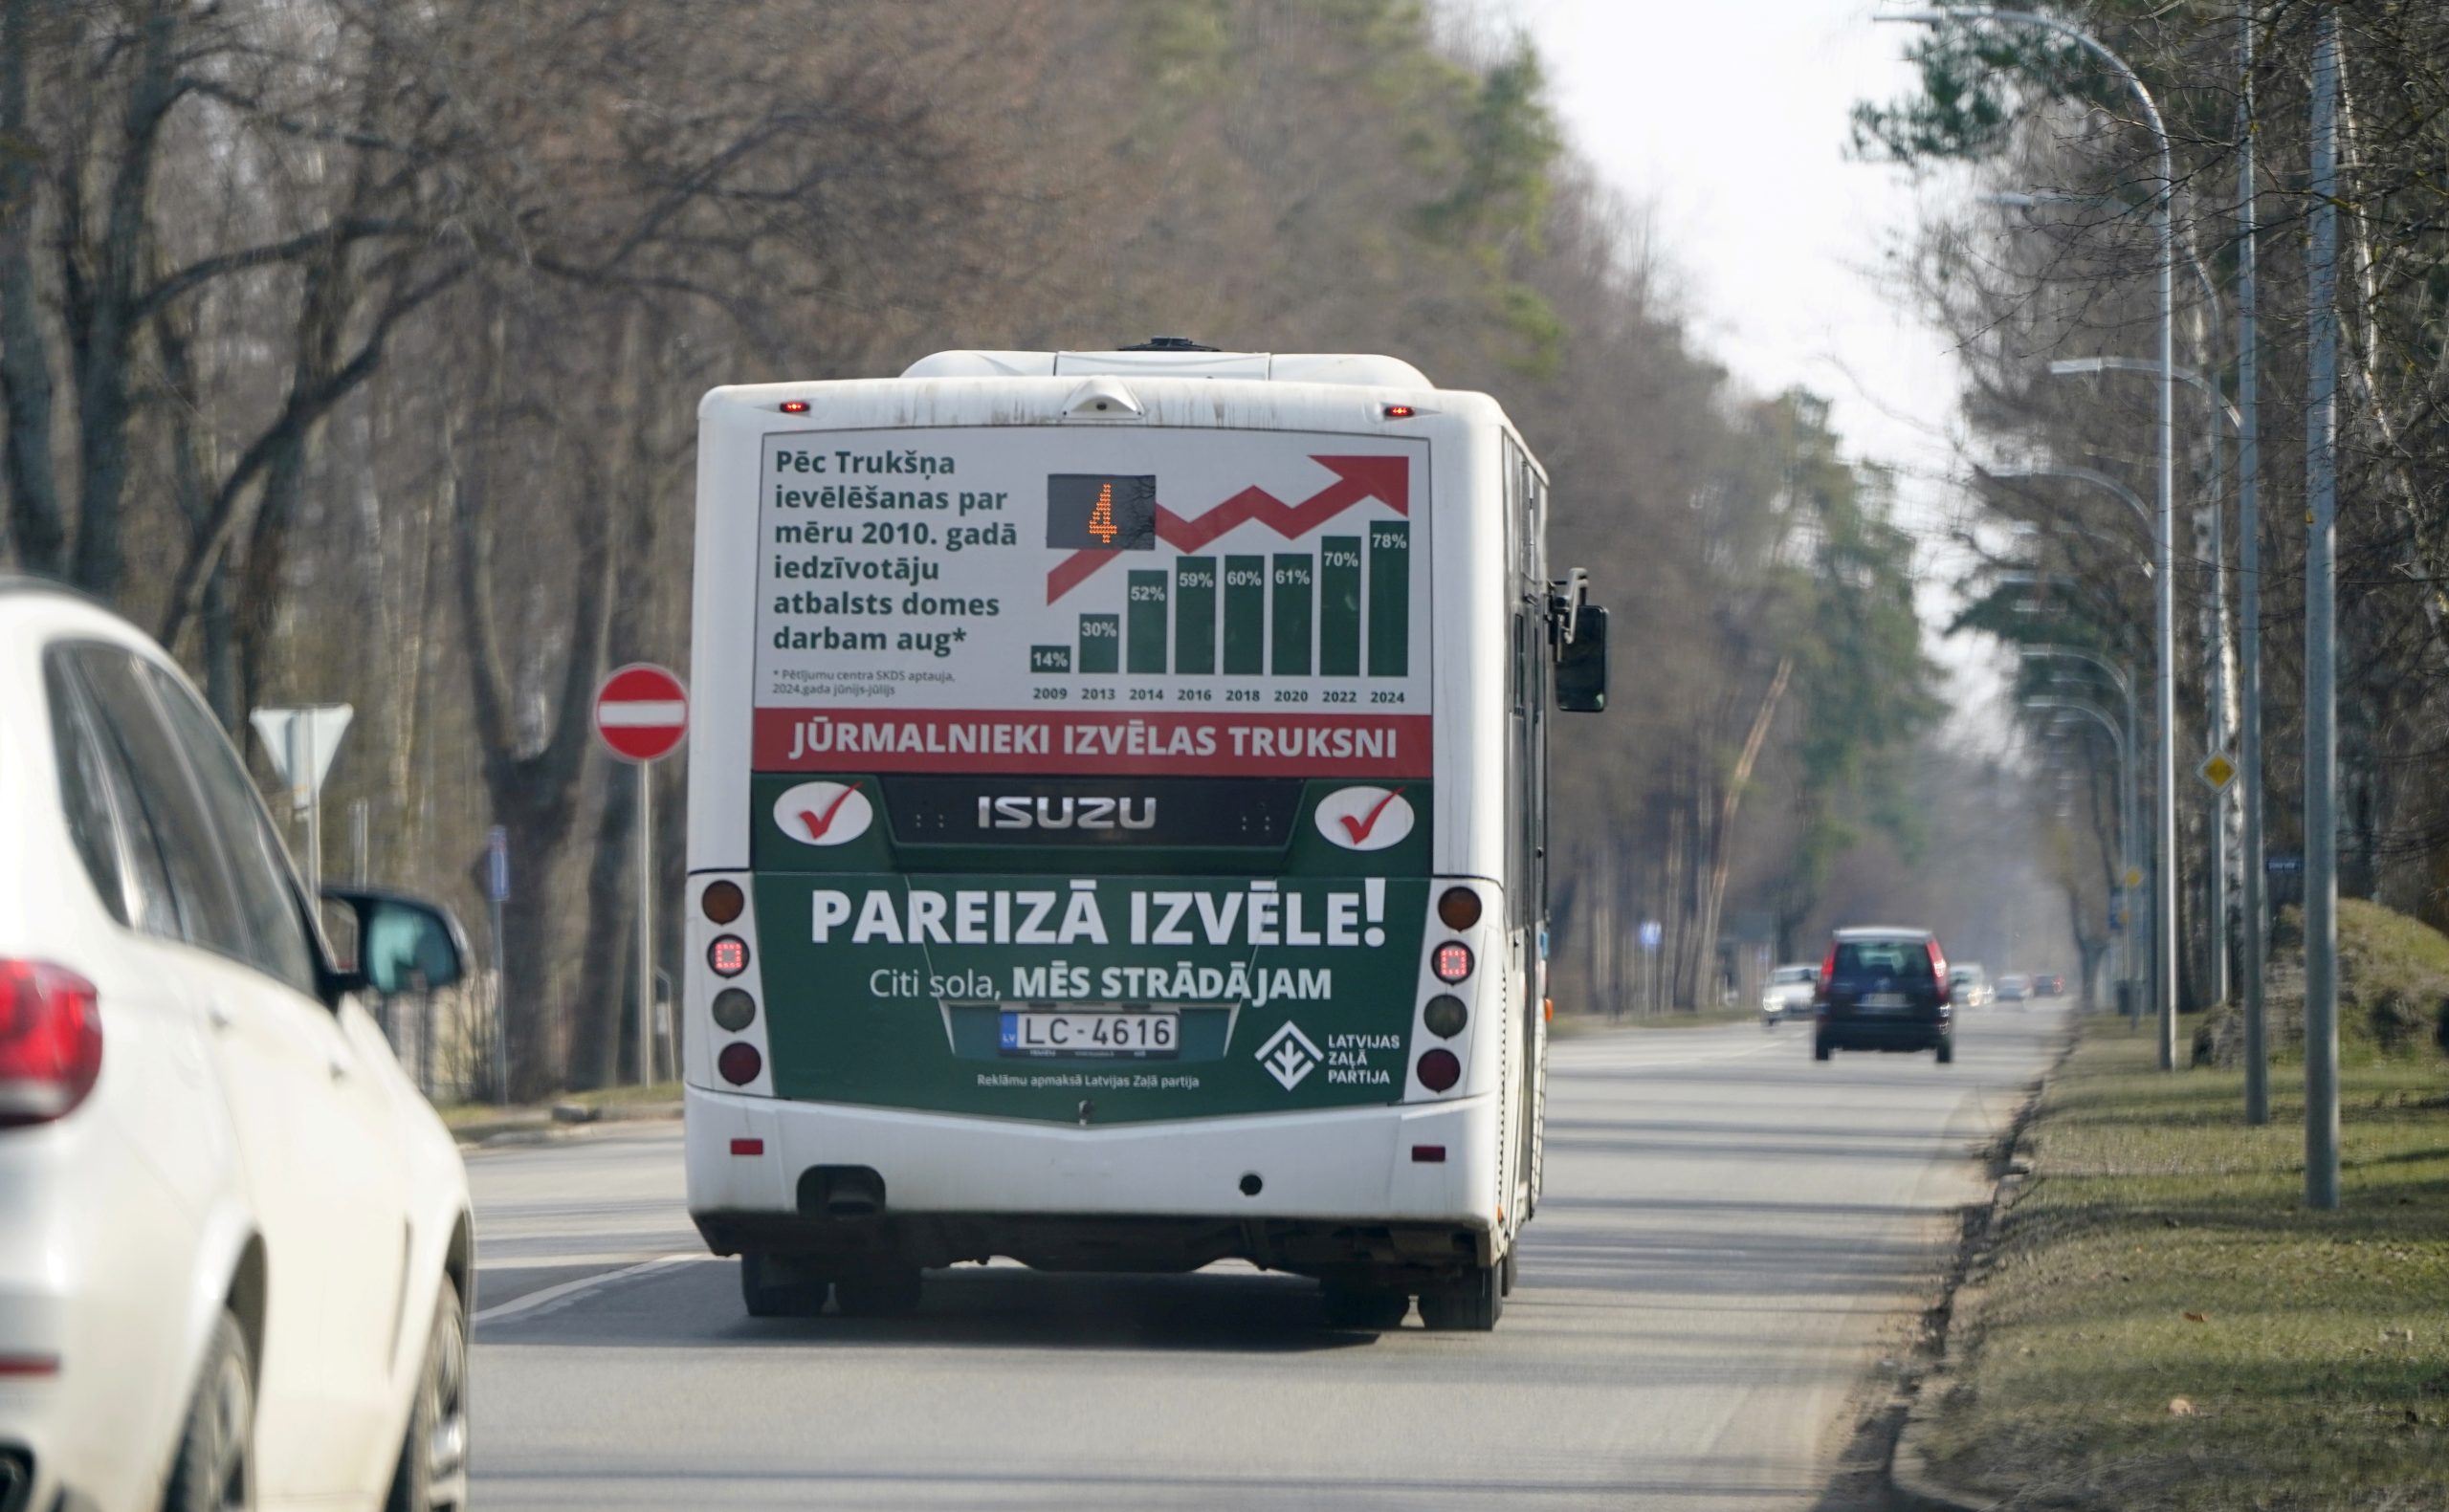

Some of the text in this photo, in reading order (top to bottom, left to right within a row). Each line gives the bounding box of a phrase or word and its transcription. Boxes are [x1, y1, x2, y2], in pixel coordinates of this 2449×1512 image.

[776, 449, 956, 480] Pēc Trukšņa
[775, 485, 1008, 516] ievēlēšanas par
[1089, 483, 1117, 544] 4
[775, 521, 1017, 552] mēru 2010. gadā
[1372, 533, 1407, 549] 78%
[1324, 551, 1359, 568] 70%
[774, 556, 939, 586] iedzīvotāju
[1179, 571, 1214, 587] 59%
[1226, 570, 1262, 587] 60%
[1275, 569, 1311, 585] 61%
[1131, 585, 1165, 602] 52%
[773, 591, 1001, 617] atbalsts domes
[773, 626, 888, 650] darbam
[1082, 622, 1117, 638] 30%
[1033, 651, 1069, 668] 14%
[837, 671, 873, 681] centra
[876, 670, 906, 681] SKDS
[908, 670, 956, 684] aptauja,
[1033, 688, 1404, 704] 2009 2013 2014 2016 2018 2020 2022 2024
[788, 717, 1397, 759] JŪRMALNIEKI IZVĒLAS TRUKSNI
[978, 796, 1157, 829] ISUZU
[811, 878, 1386, 947] PAREIZĀ IZVĒLE!
[870, 960, 1332, 1007] Citi sola, MĒS STRĀDĀJAM
[1026, 1018, 1169, 1045] LC-4616
[1328, 1034, 1401, 1049] LATVIJAS
[1328, 1049, 1368, 1069] ZAĻĀ
[977, 1073, 1200, 1090] Reklāmu apmaksā Latvijas Zaļā partija
[1328, 1069, 1390, 1085] PARTIJA
